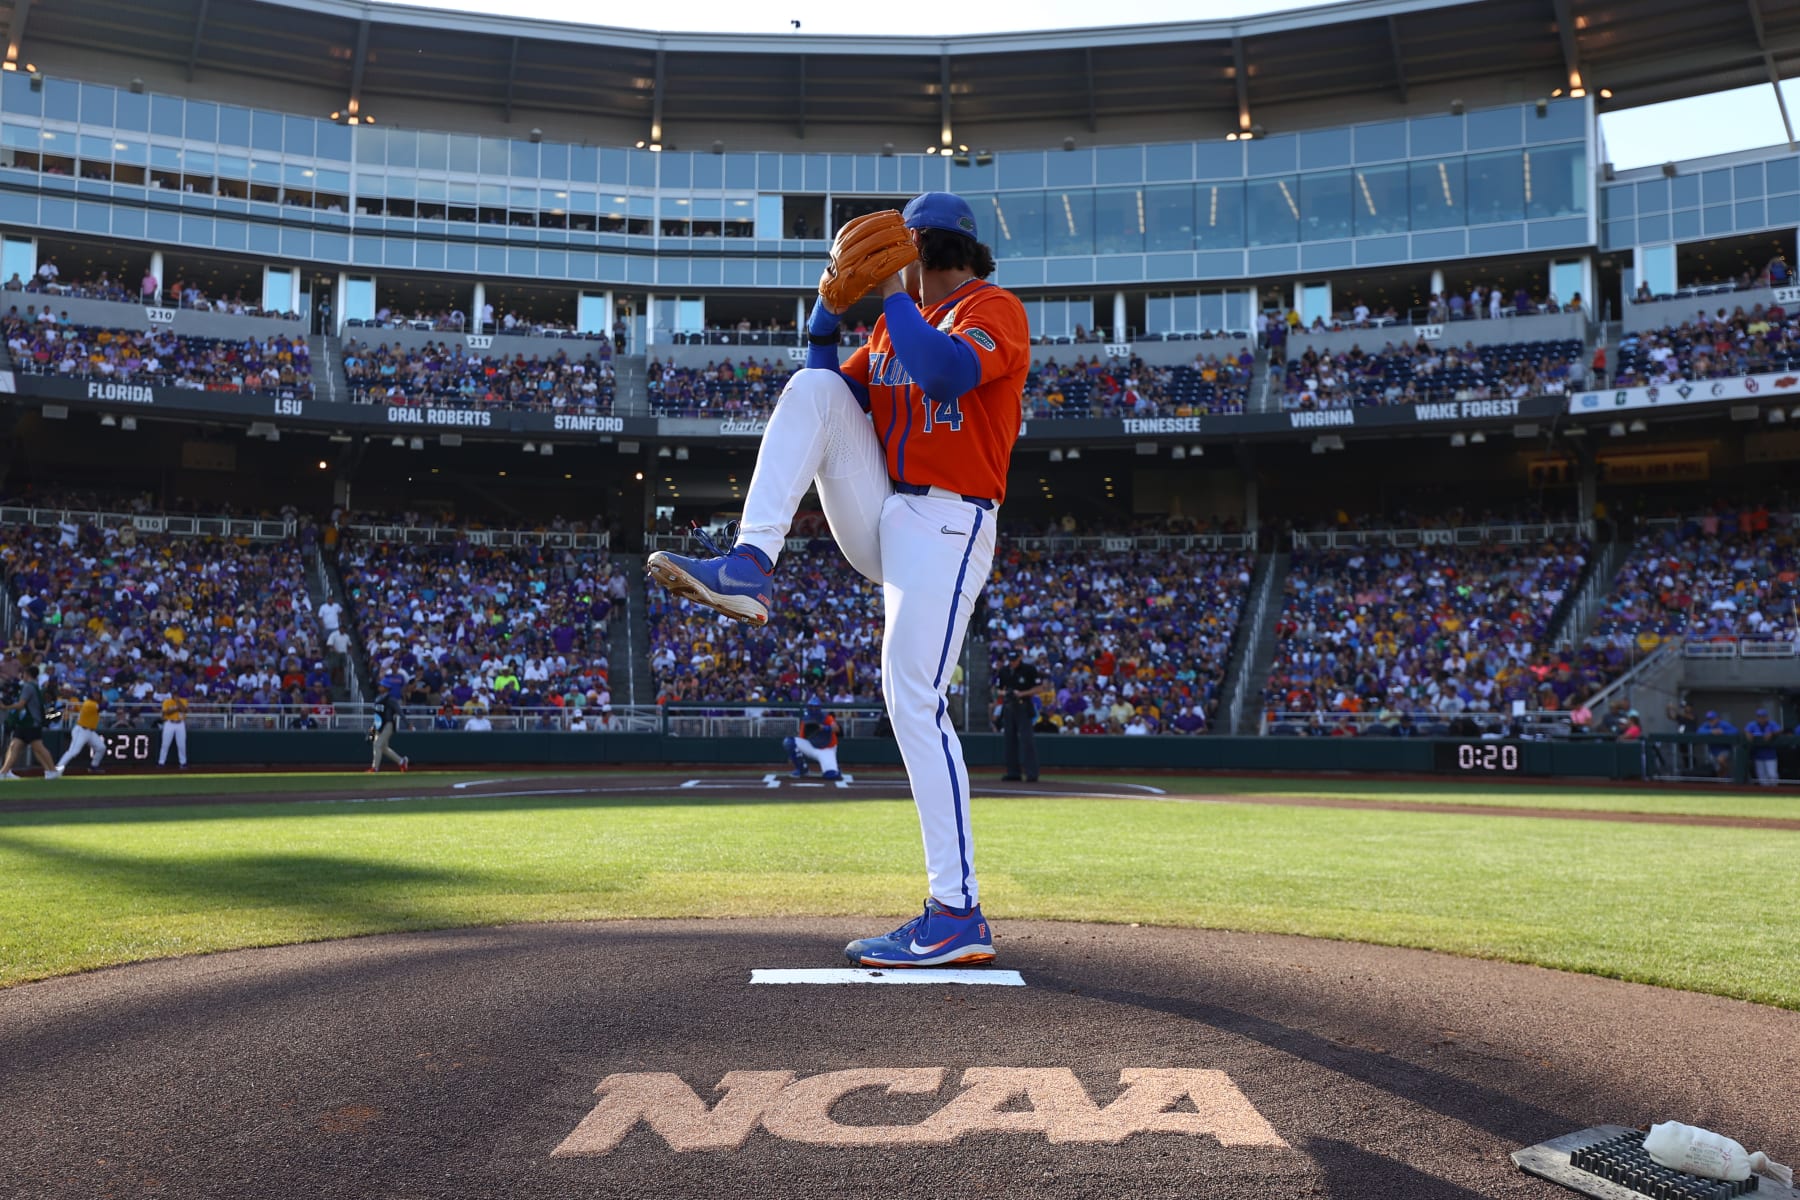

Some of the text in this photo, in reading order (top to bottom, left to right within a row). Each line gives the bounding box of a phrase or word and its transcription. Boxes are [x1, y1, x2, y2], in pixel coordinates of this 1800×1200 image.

[150, 310, 172, 320] 210
[470, 337, 489, 346] 211
[88, 381, 154, 403] FLORIDA
[274, 399, 302, 416] LSU
[387, 407, 491, 426] ORAL ROBERTS
[922, 393, 964, 433] 14
[1415, 400, 1520, 421] WAKE FOREST
[554, 415, 624, 433] STANFORD
[1122, 417, 1201, 434] TENNESSEE
[1290, 409, 1355, 428] VIRGINIA
[138, 519, 159, 529] 110
[1458, 744, 1518, 769] 0:20
[550, 1066, 1291, 1157] NCAA
